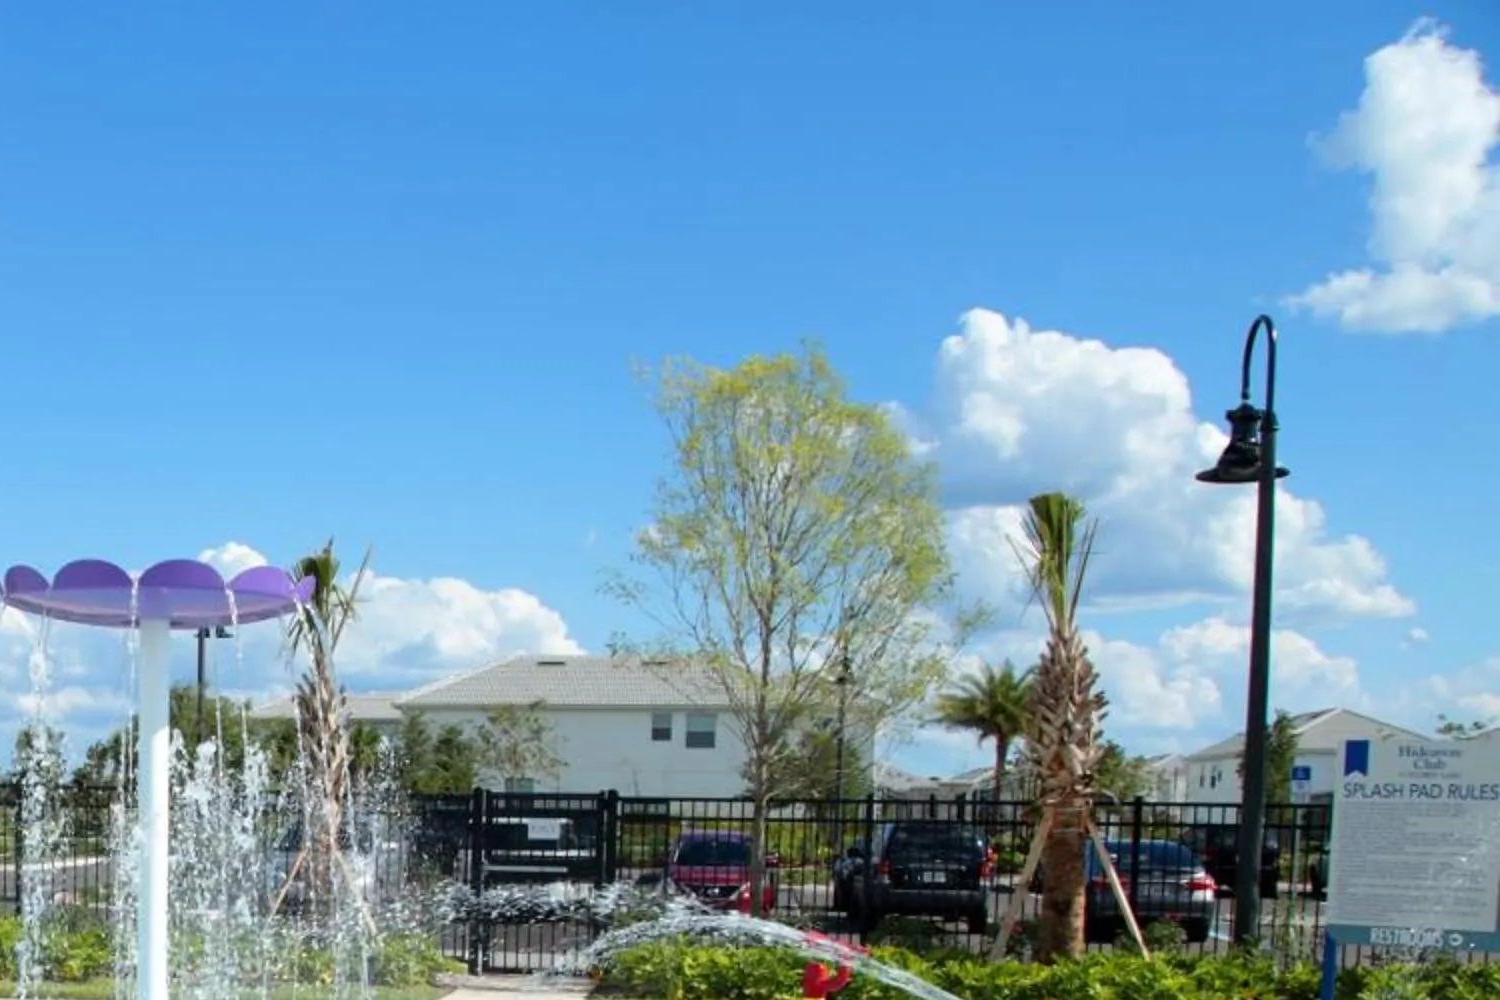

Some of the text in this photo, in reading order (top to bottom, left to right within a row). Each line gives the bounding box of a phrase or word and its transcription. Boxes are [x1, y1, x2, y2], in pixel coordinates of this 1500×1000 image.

[1343, 783, 1499, 801] SPLASH PAD RULES
